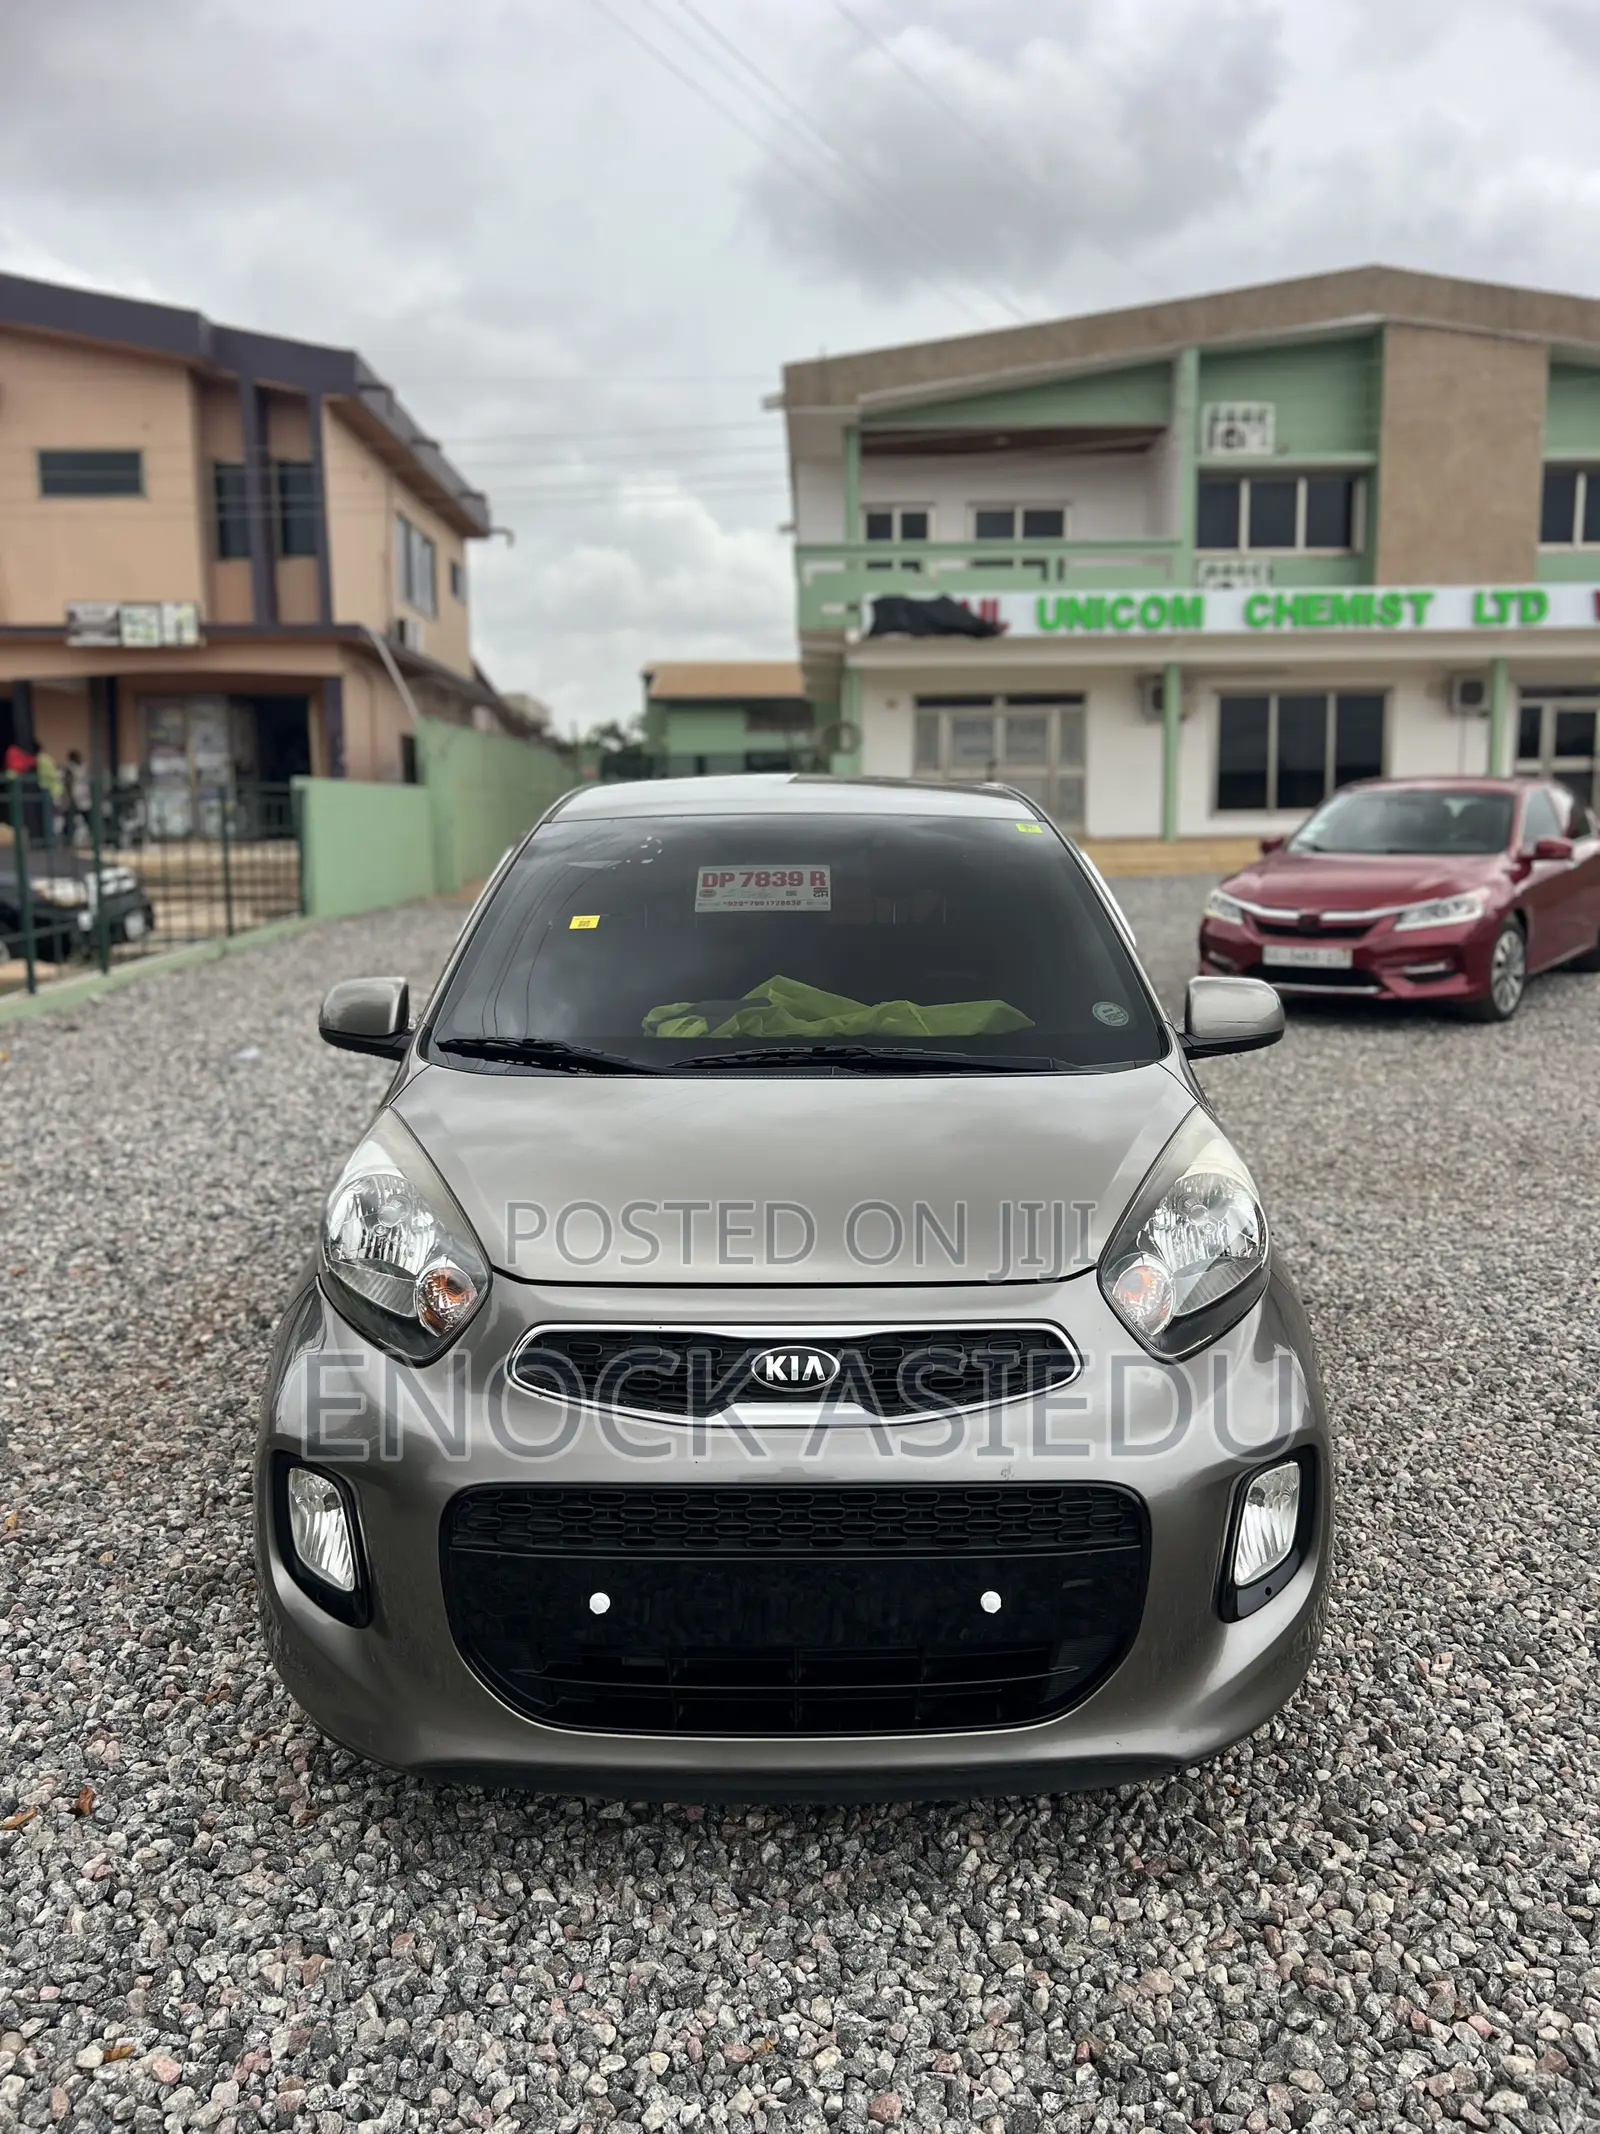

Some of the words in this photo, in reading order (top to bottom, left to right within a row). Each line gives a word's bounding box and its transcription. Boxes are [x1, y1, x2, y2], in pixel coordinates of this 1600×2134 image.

[1036, 595, 1206, 631] UNICOM
[1244, 590, 1434, 627] CHEMIST
[1473, 589, 1549, 625] LTD
[702, 872, 735, 887] DP
[739, 871, 804, 887] 7839
[809, 871, 826, 886] R
[765, 1356, 826, 1381] KIA
